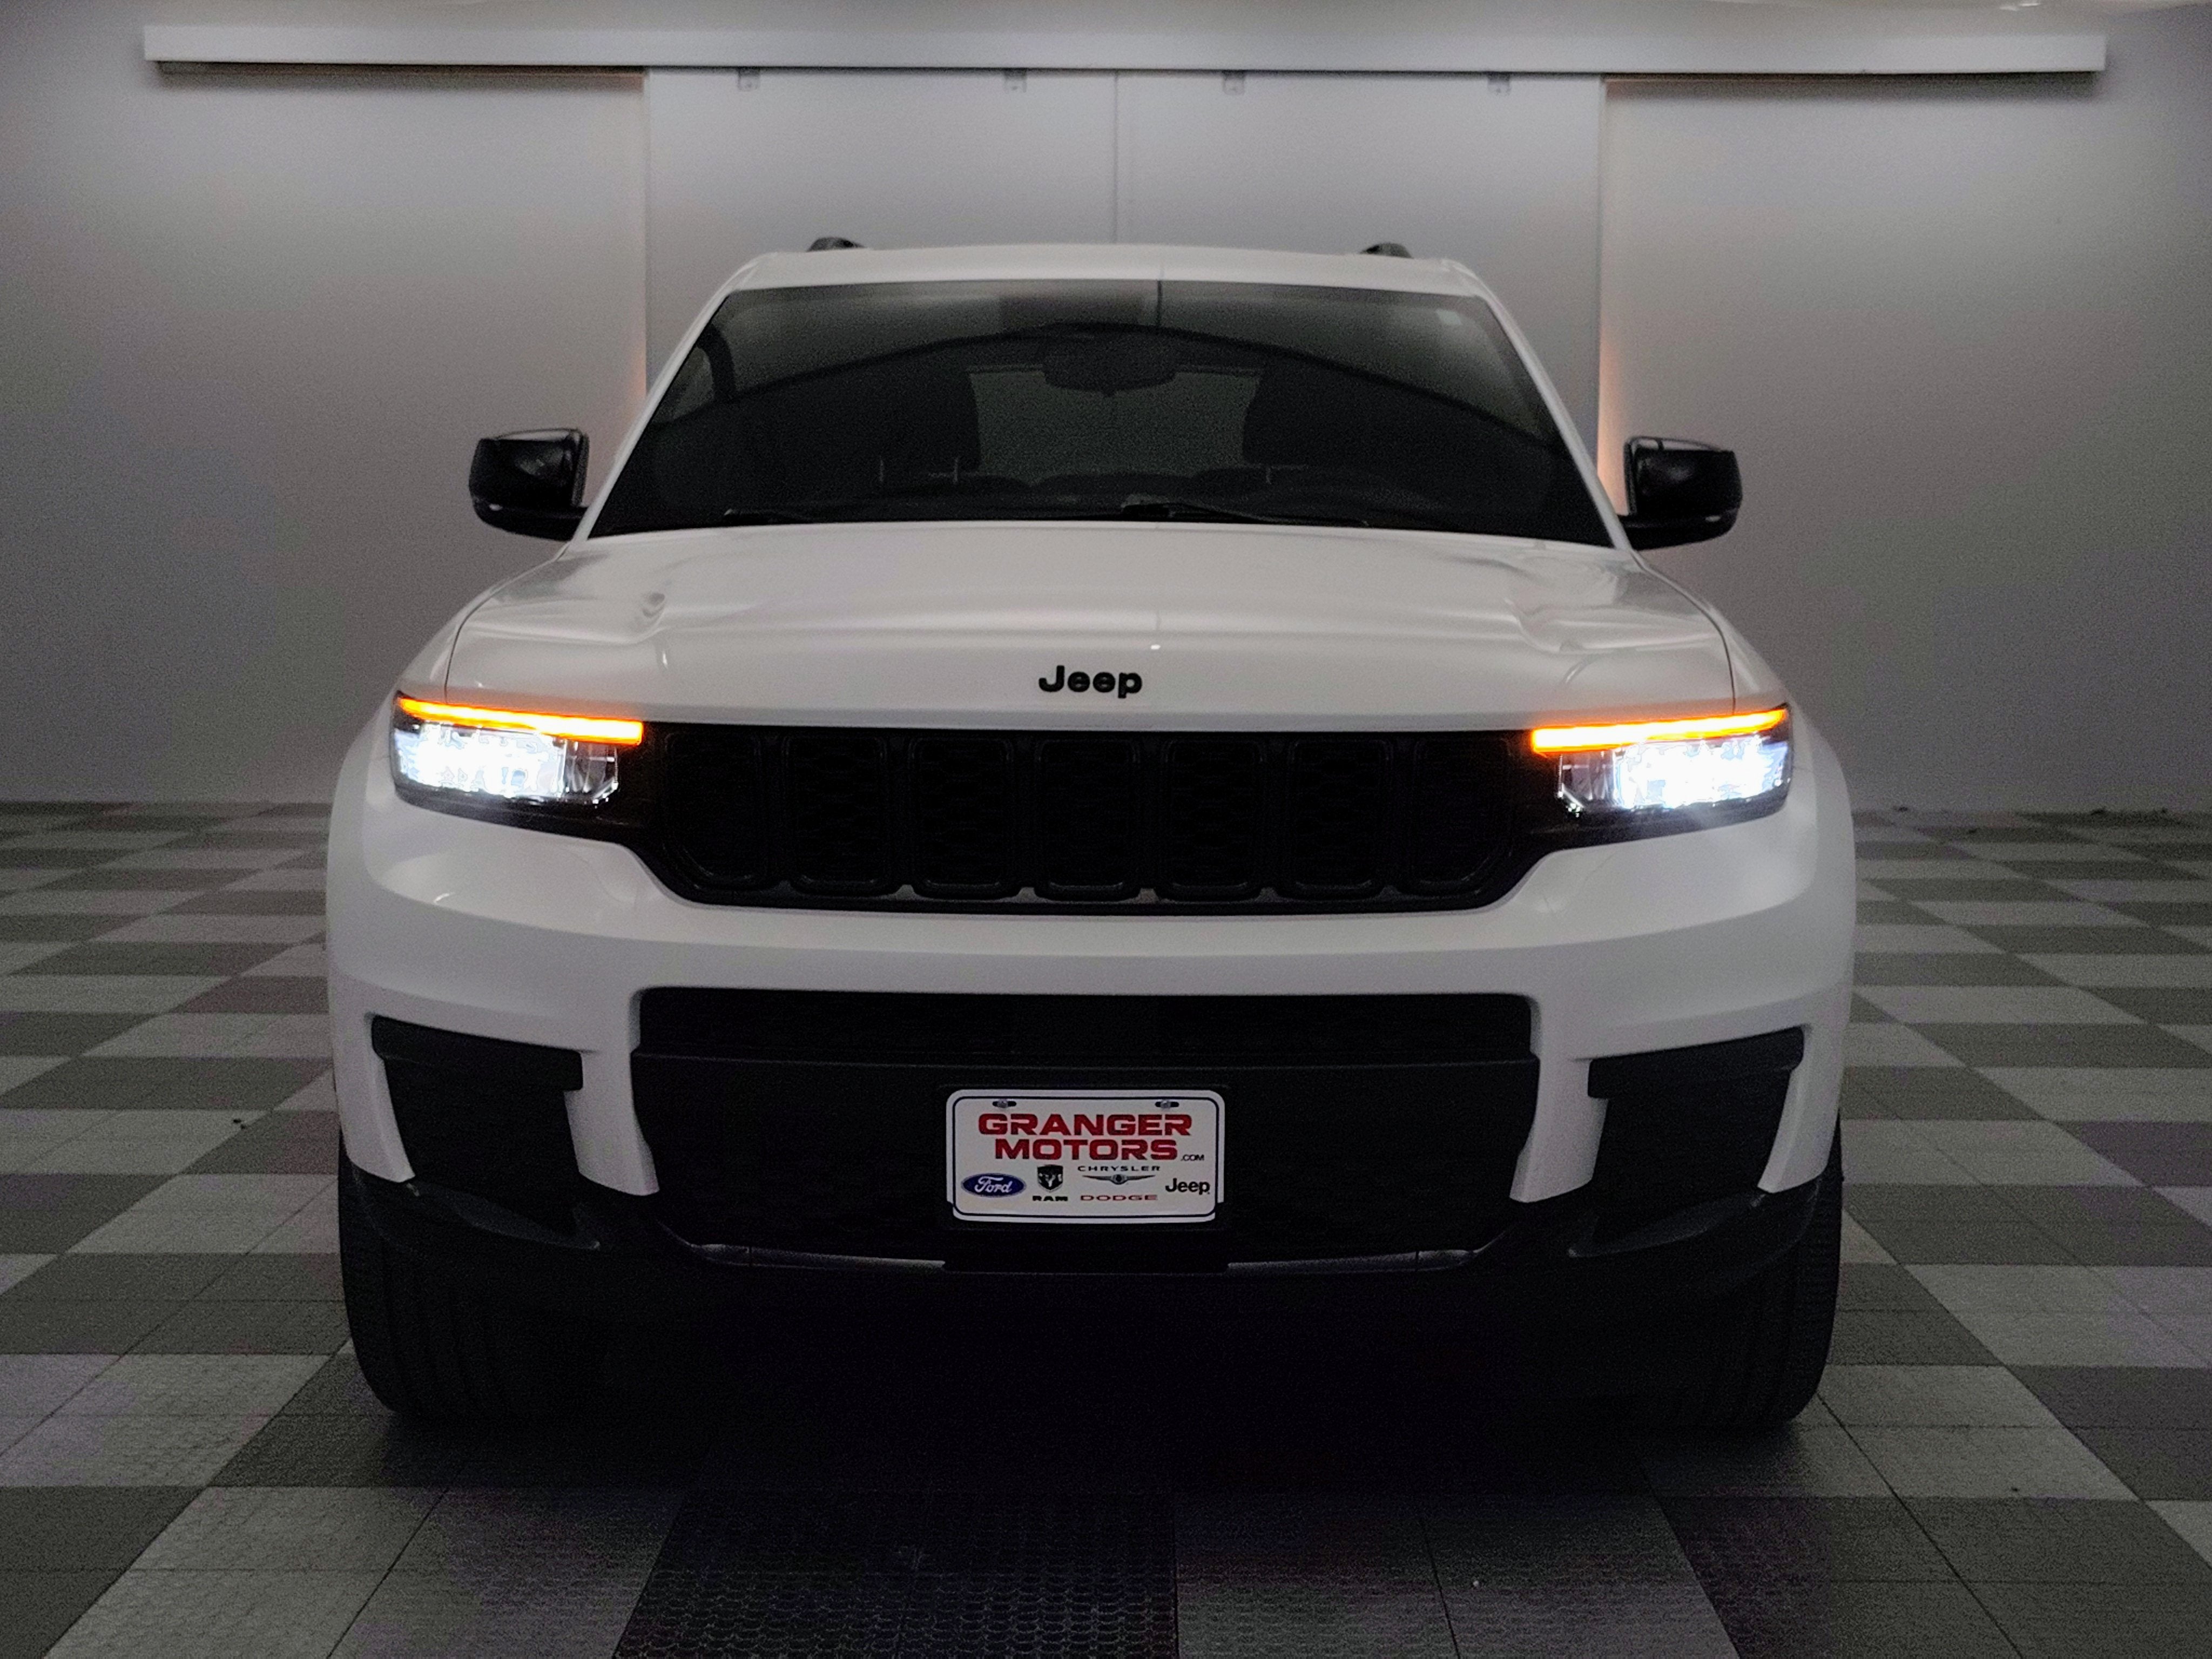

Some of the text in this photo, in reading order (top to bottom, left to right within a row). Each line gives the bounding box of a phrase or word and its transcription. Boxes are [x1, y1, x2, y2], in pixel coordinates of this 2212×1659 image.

[1038, 665, 1142, 698] Jeep
[979, 1114, 1192, 1136] GRANGER
[995, 1139, 1178, 1160] MOTORS
[974, 1176, 1012, 1193] Ford
[1165, 1178, 1210, 1195] Jeep
